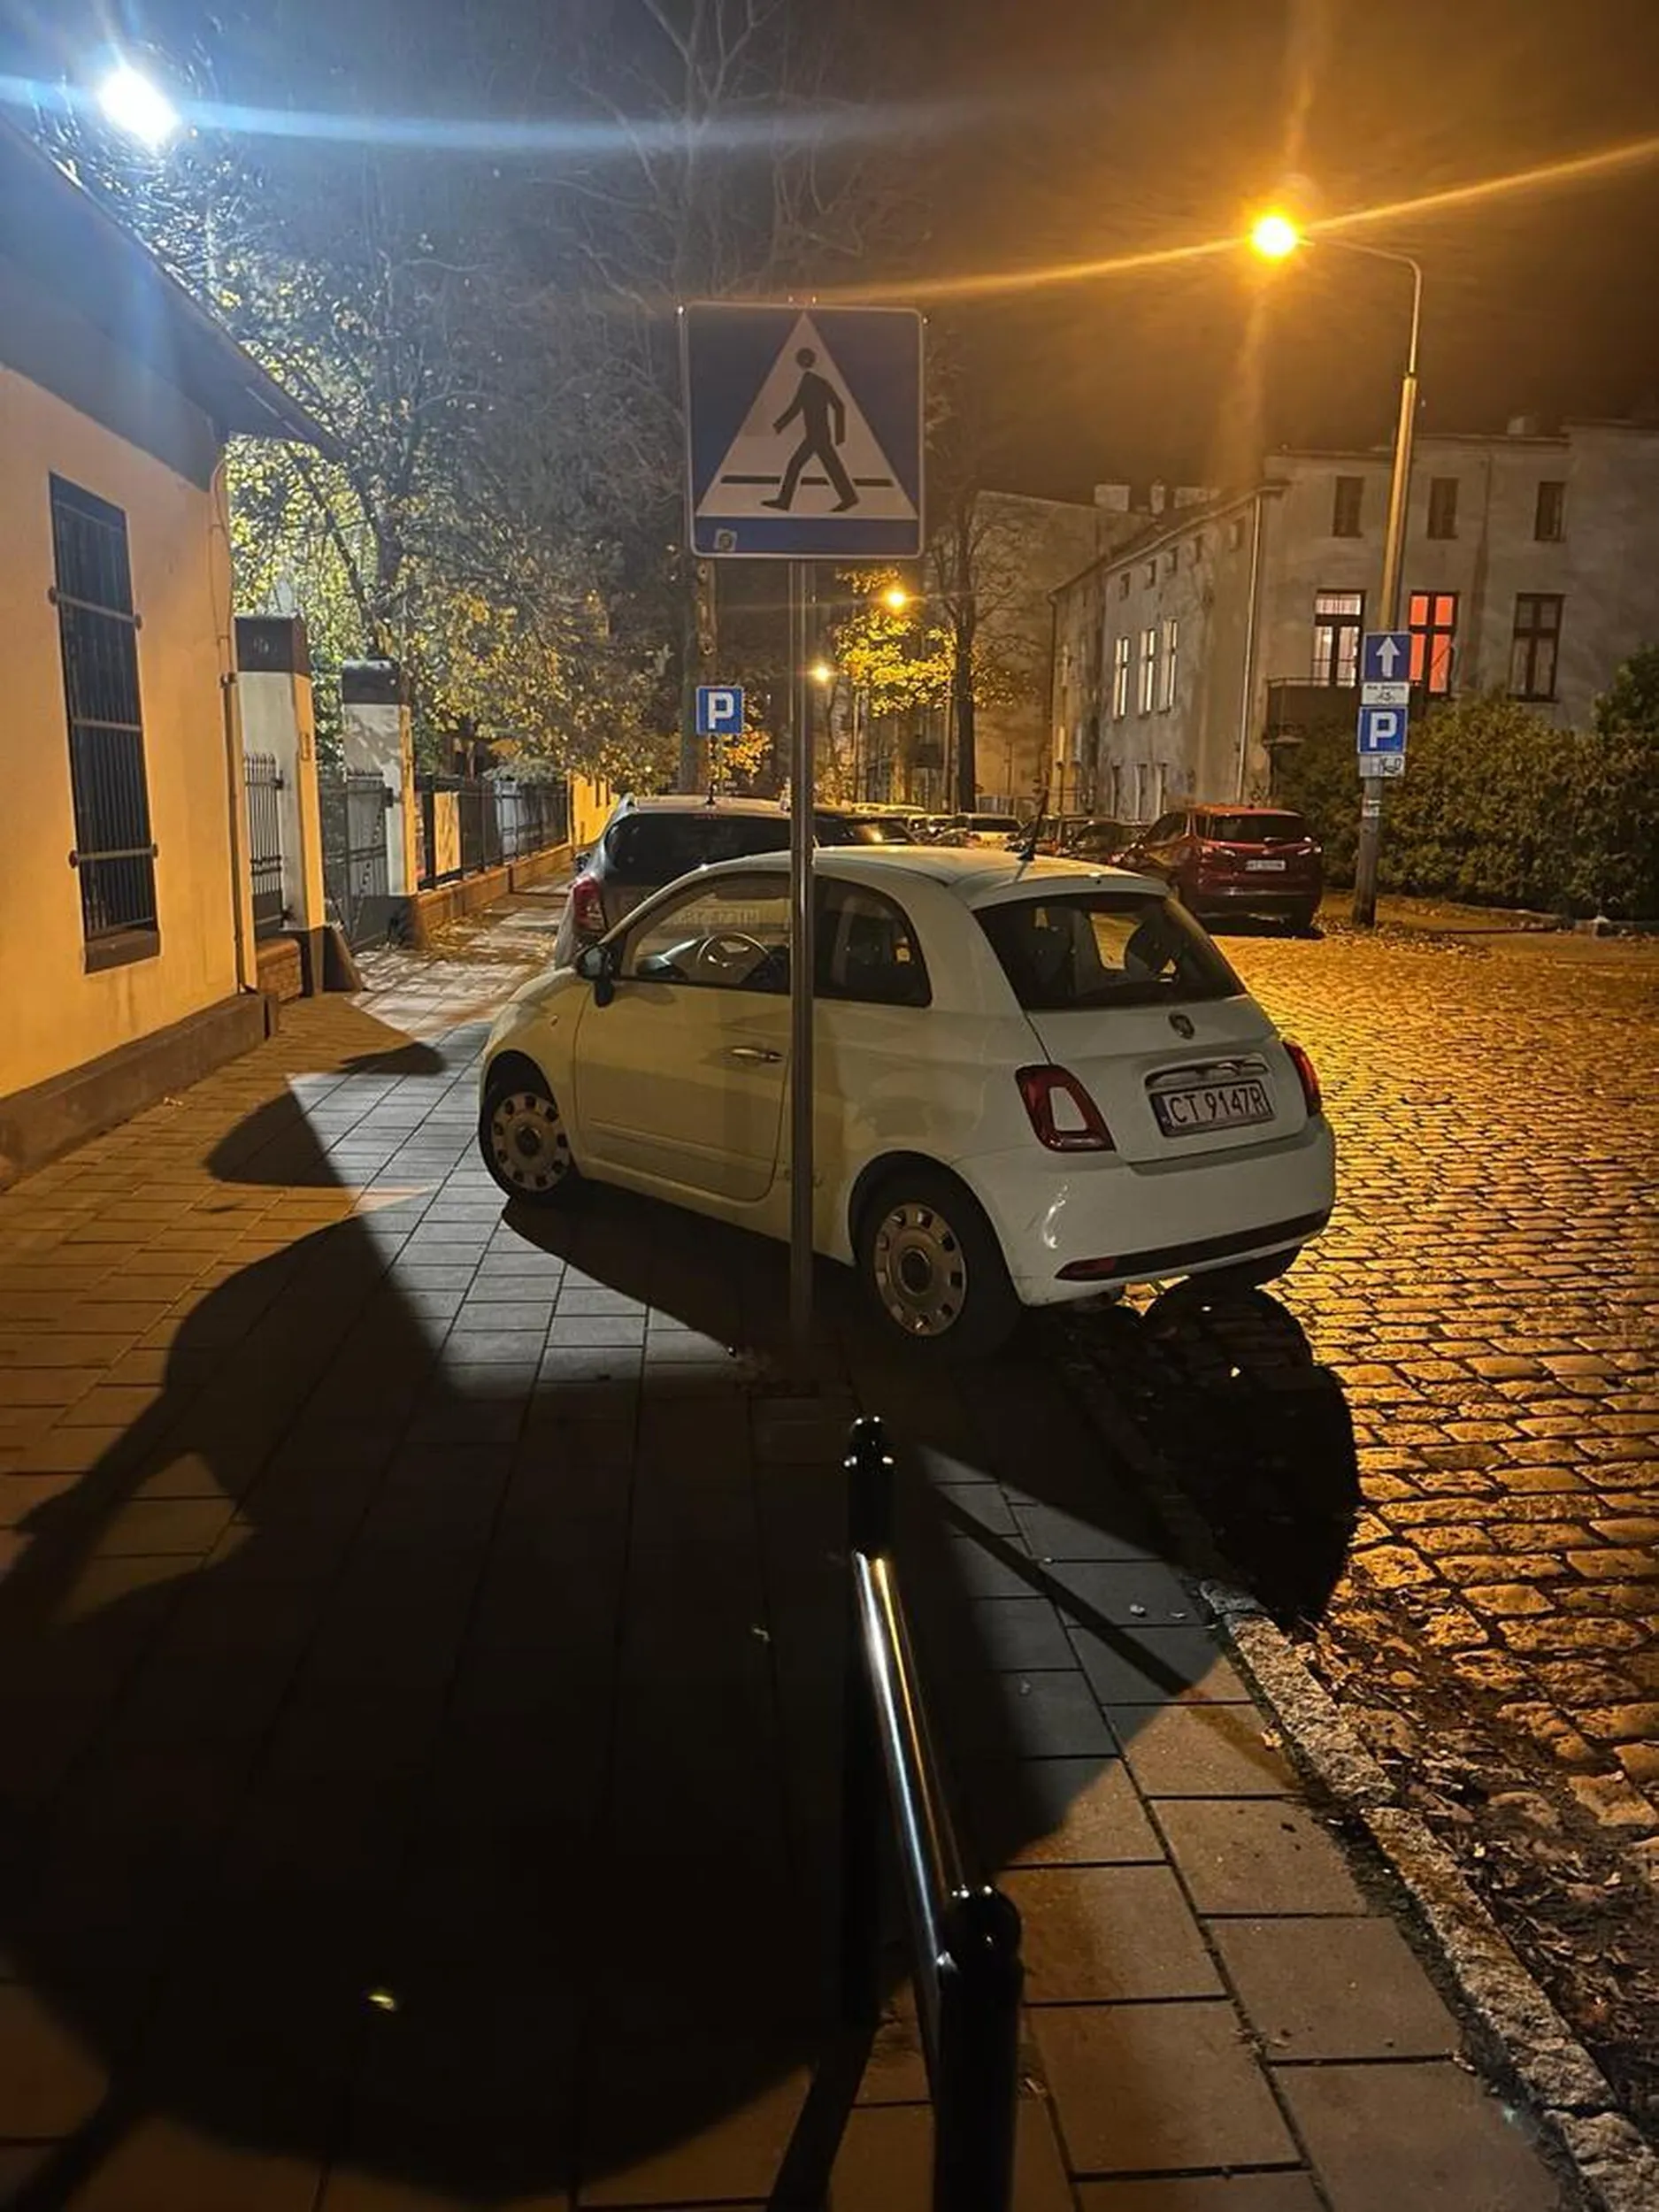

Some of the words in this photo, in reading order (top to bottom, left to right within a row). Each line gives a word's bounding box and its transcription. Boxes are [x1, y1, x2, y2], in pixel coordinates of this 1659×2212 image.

[708, 692, 734, 730] P
[1369, 711, 1398, 749] P
[1169, 1094, 1200, 1124] CT
[1204, 1087, 1266, 1119] 9147R
